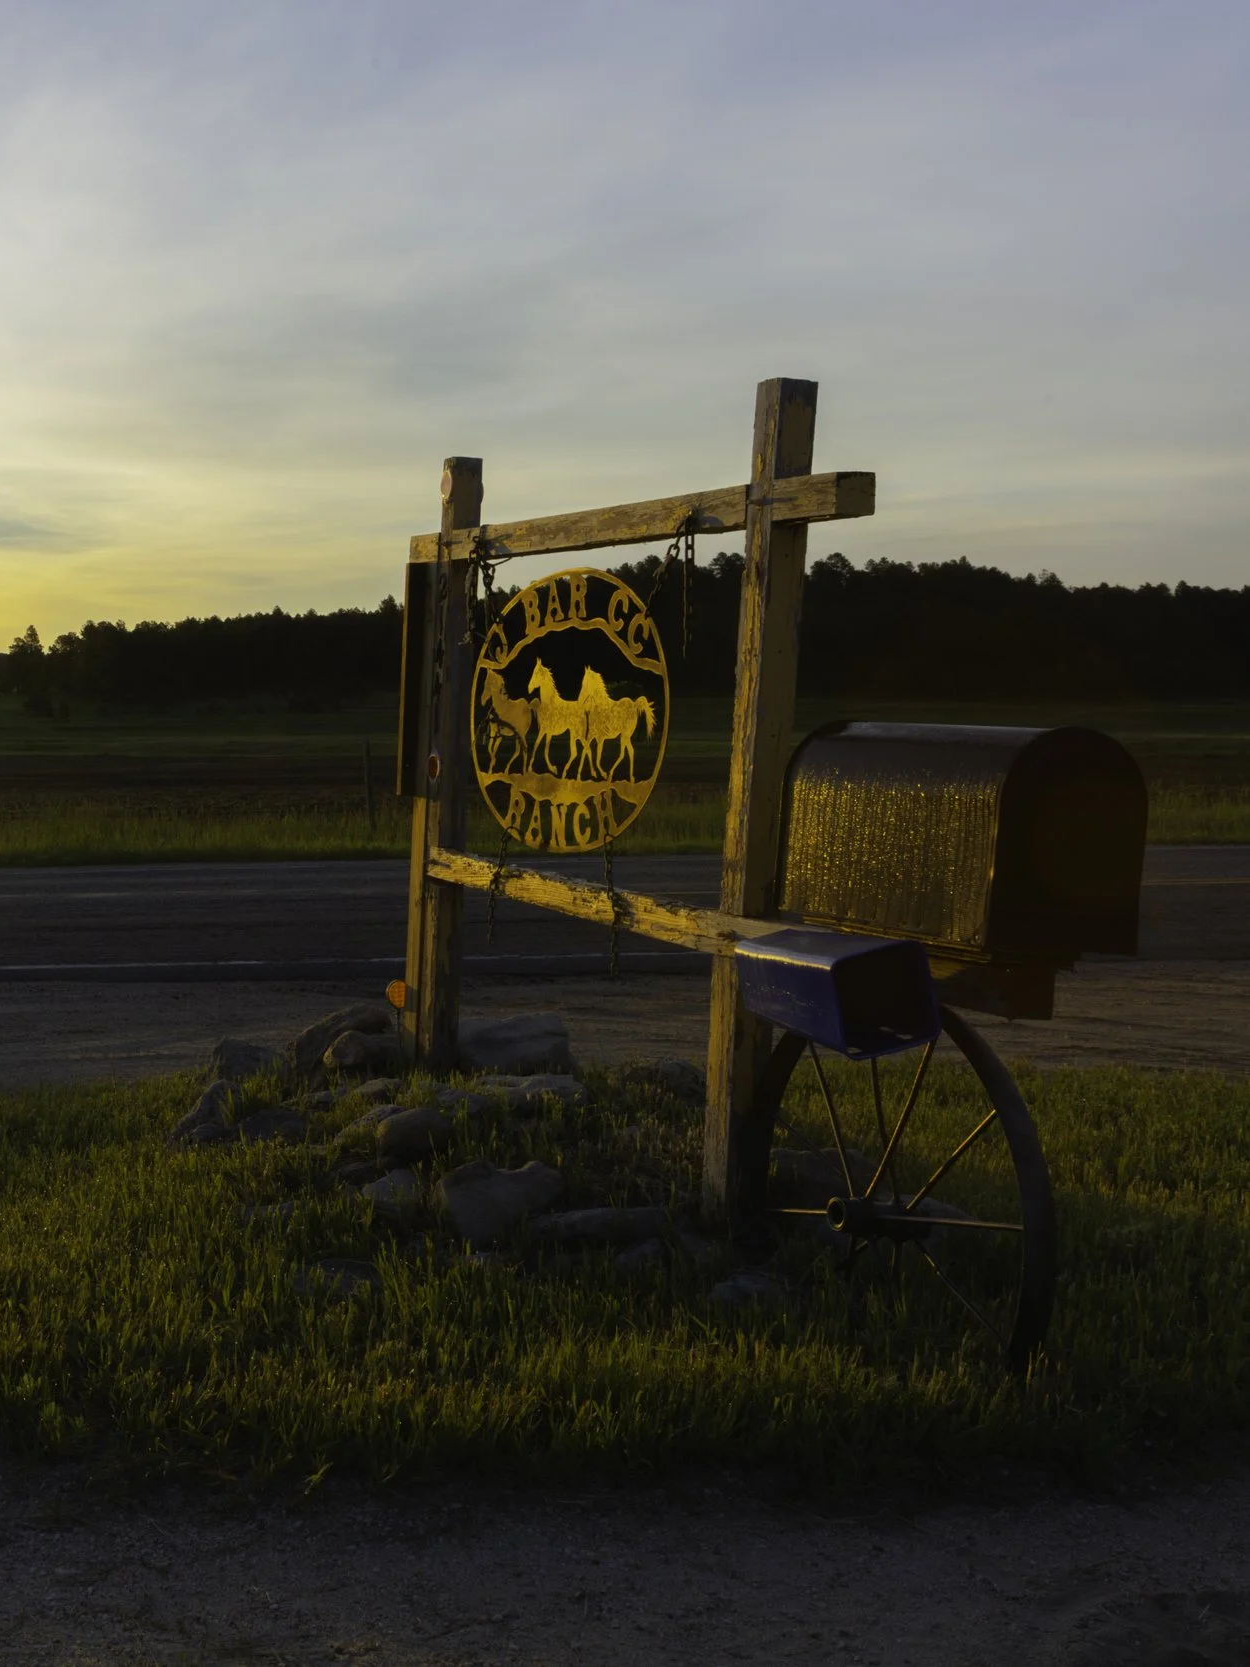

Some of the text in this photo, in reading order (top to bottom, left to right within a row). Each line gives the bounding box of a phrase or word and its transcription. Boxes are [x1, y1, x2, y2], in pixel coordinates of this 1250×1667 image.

[494, 622, 509, 664] J
[521, 574, 587, 636] BAR
[504, 785, 618, 852] RANCH
